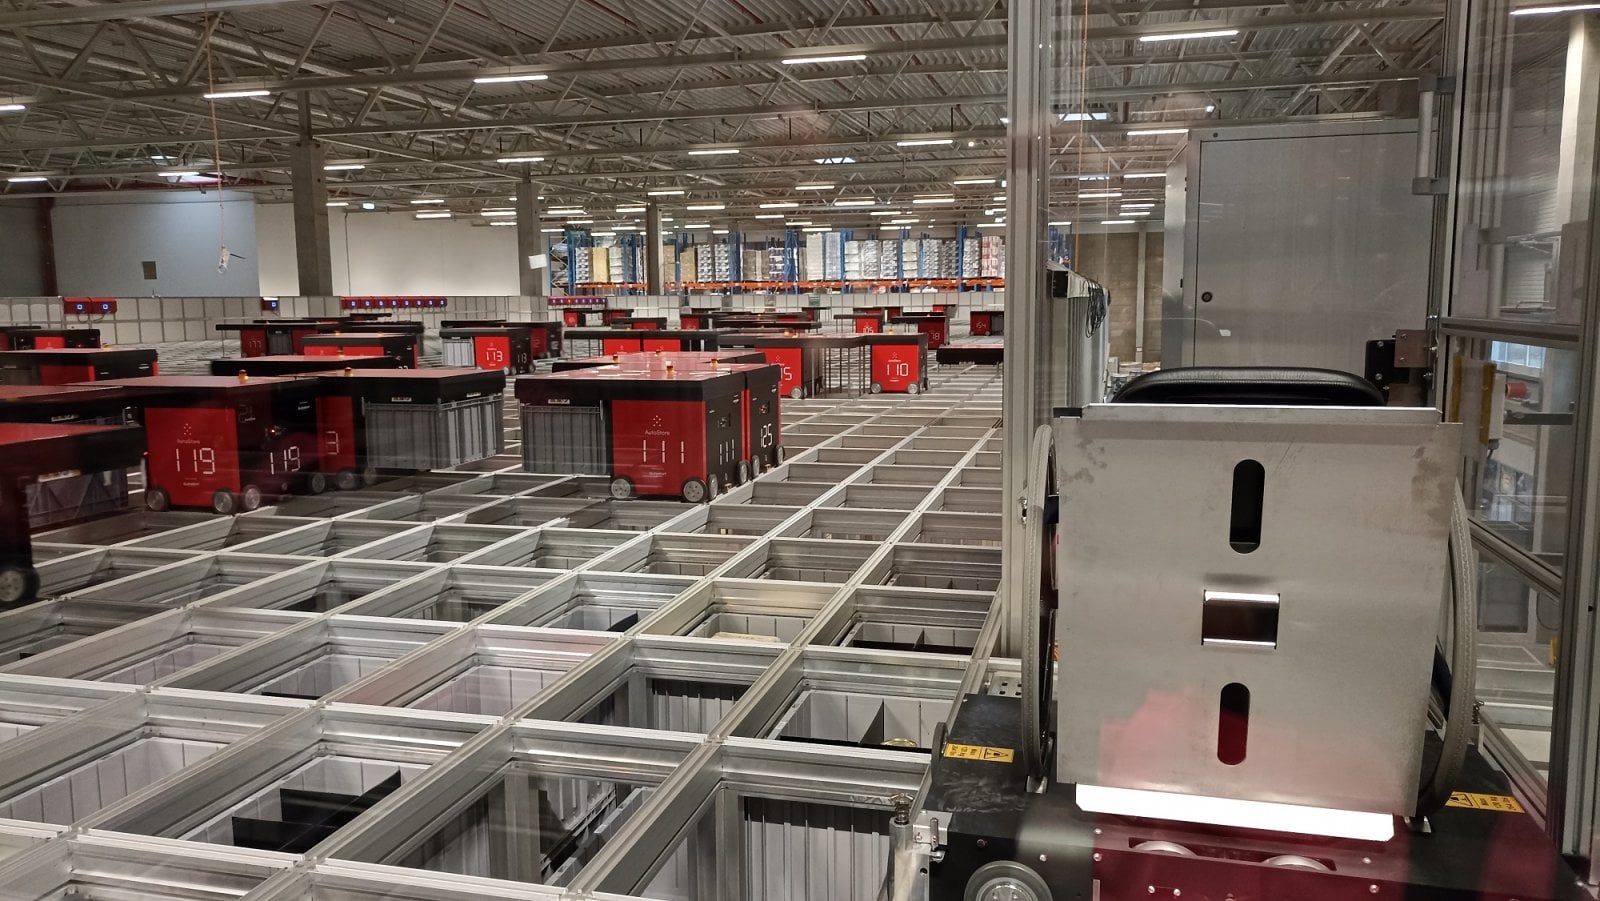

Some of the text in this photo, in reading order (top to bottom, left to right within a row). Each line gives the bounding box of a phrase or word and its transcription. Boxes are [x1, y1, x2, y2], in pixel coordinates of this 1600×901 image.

[486, 350, 503, 362] 113
[886, 363, 909, 377] 110
[760, 423, 773, 449] 125
[176, 447, 216, 475] 119
[270, 445, 302, 475] 119
[643, 439, 685, 465] 111
[719, 439, 736, 466] 111
